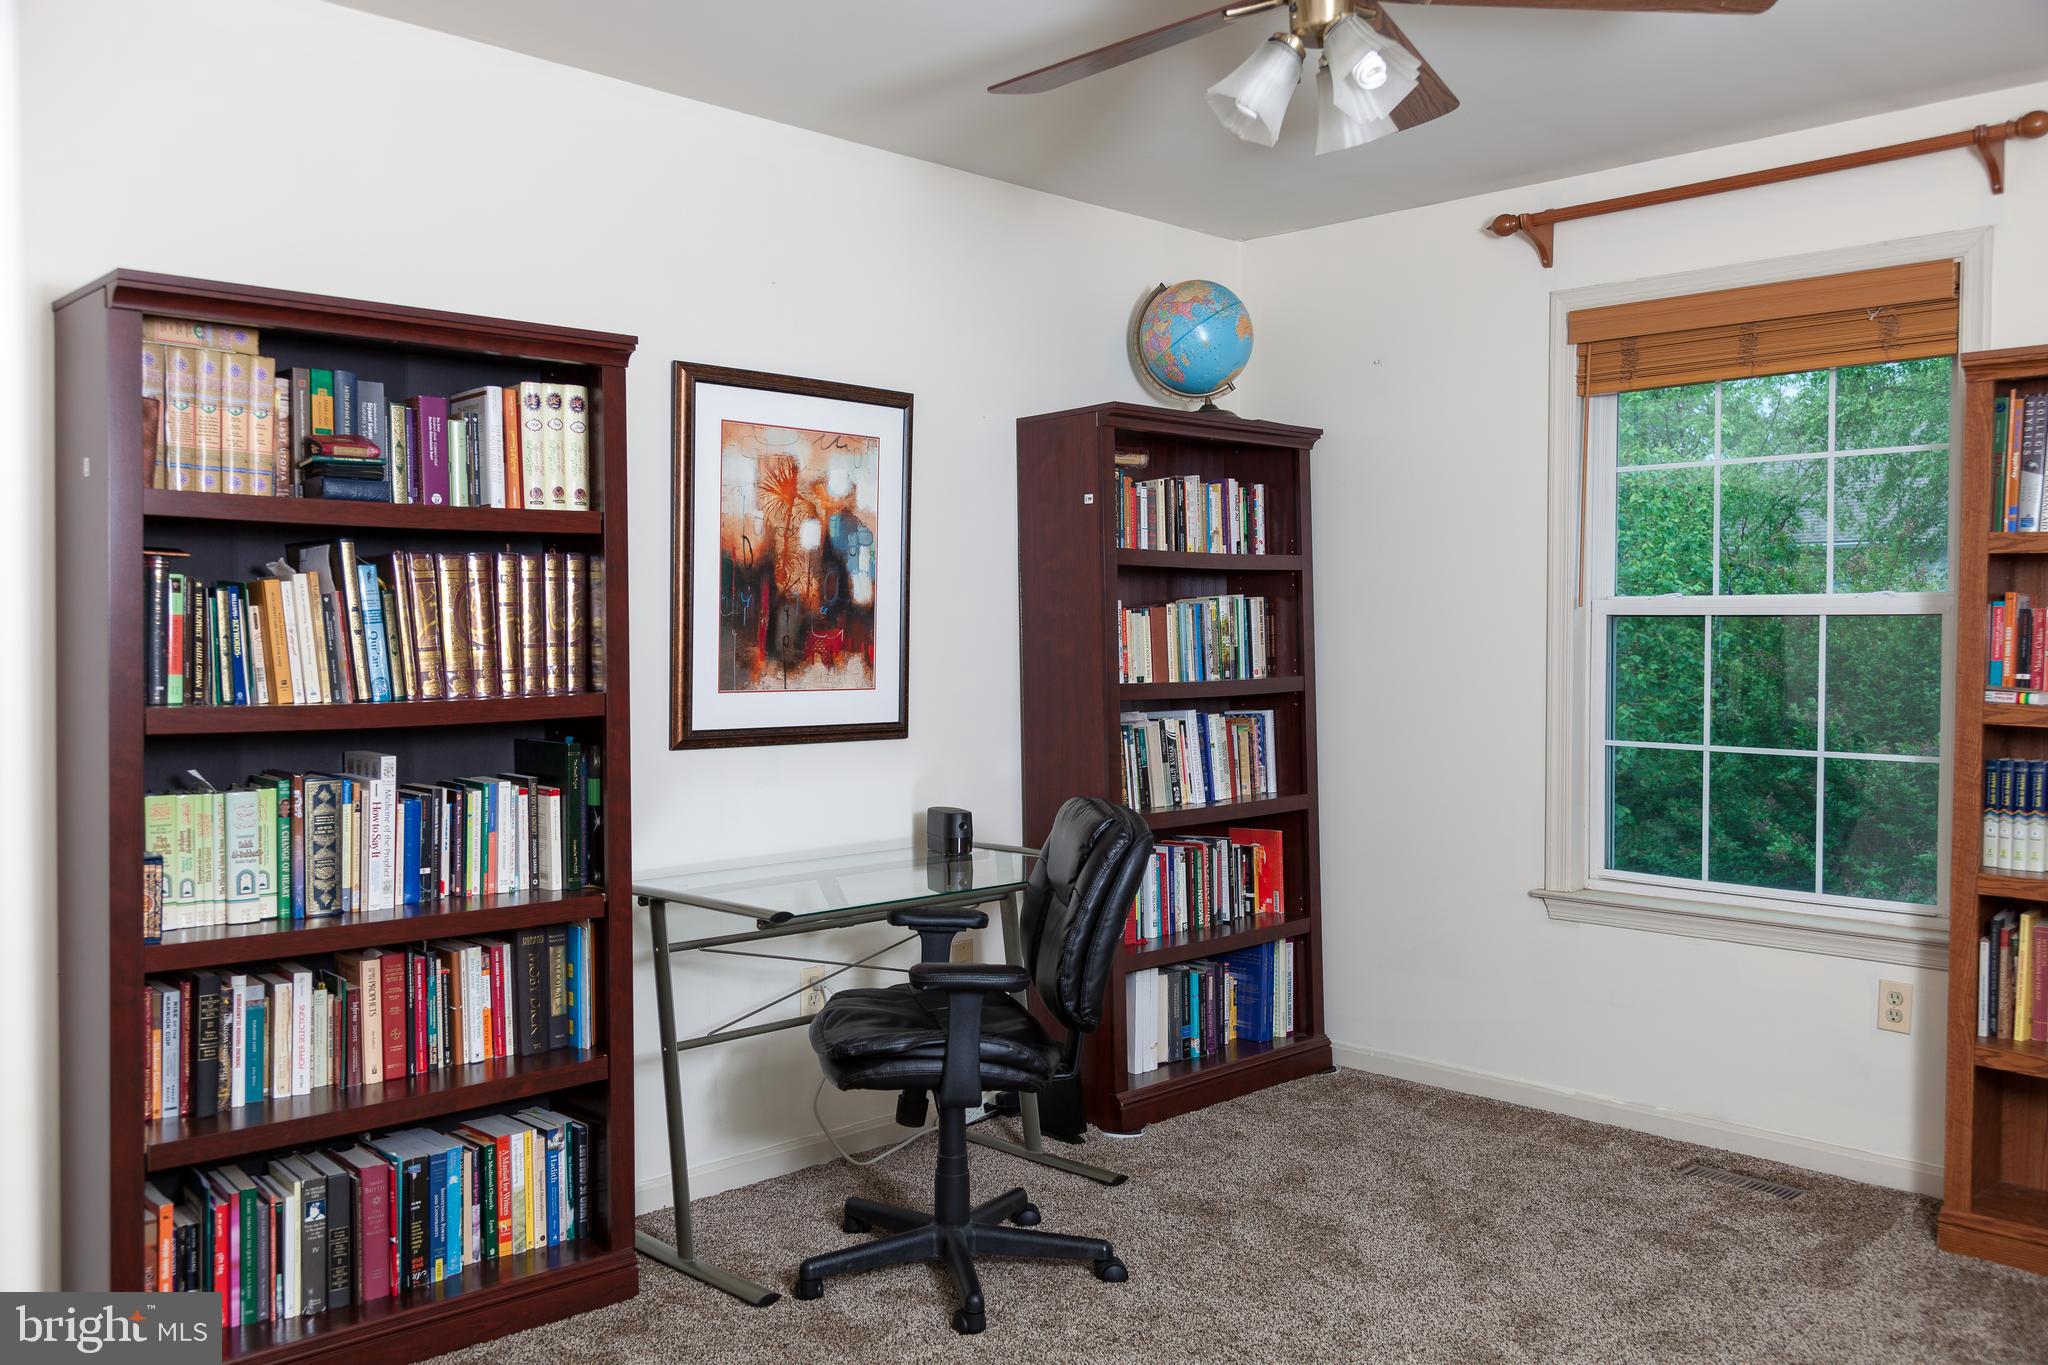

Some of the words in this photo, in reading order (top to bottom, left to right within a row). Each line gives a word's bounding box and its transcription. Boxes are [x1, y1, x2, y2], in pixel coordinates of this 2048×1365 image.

[2023, 402, 2034, 456] PHYSICS
[2034, 401, 2045, 456] COLLEGE
[233, 619, 241, 656] KEYWORDS
[370, 631, 381, 668] Qur'an
[372, 801, 382, 823] How
[384, 789, 393, 823] Medicine
[372, 824, 381, 833] to
[384, 825, 393, 833] of
[384, 835, 393, 846] the
[281, 830, 290, 858] CHANGE
[369, 834, 381, 852] Say
[281, 861, 290, 872] OF
[382, 848, 392, 878] Prophet
[281, 874, 290, 898] HEART
[528, 953, 540, 992] MOBY
[554, 952, 562, 1000] MALCOLM
[351, 1002, 359, 1022] Inferno
[368, 981, 377, 1017] PROPHETS
[528, 997, 540, 1036] DICK
[502, 1156, 510, 1182] Manual
[550, 1154, 558, 1184] Hadith
[365, 1186, 386, 1194] Berlin
[502, 1183, 510, 1192] for
[579, 1185, 588, 1195] IS
[502, 1193, 510, 1216] Writers
